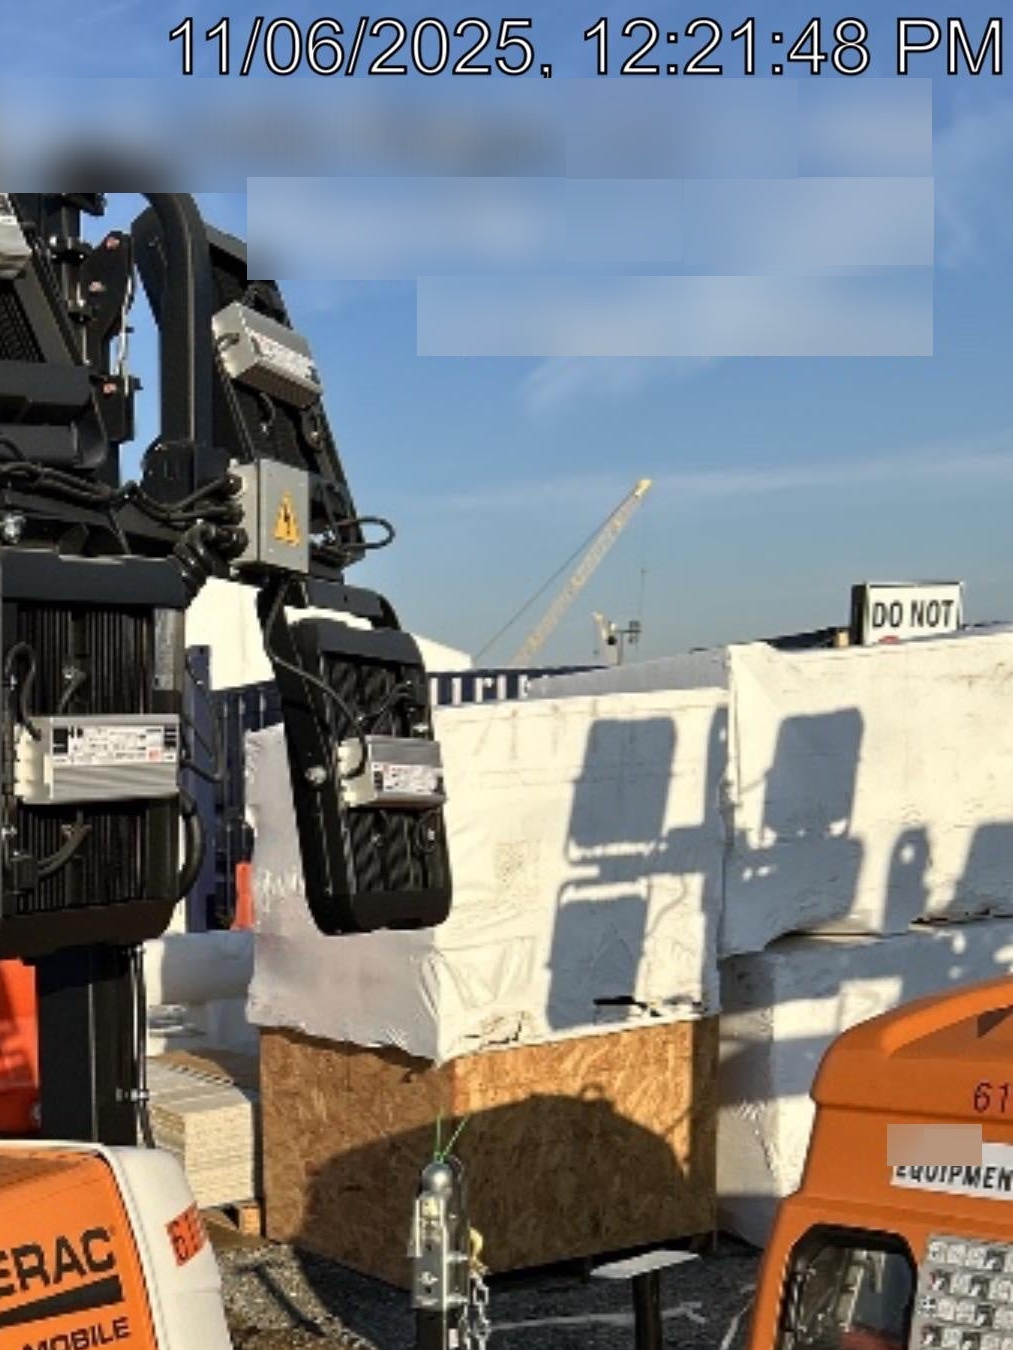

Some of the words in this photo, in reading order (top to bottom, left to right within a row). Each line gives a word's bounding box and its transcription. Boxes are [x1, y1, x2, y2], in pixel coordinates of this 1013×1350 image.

[872, 602, 903, 628] DO
[911, 599, 955, 628] NOT
[895, 1165, 1013, 1192] EQUIPMEN
